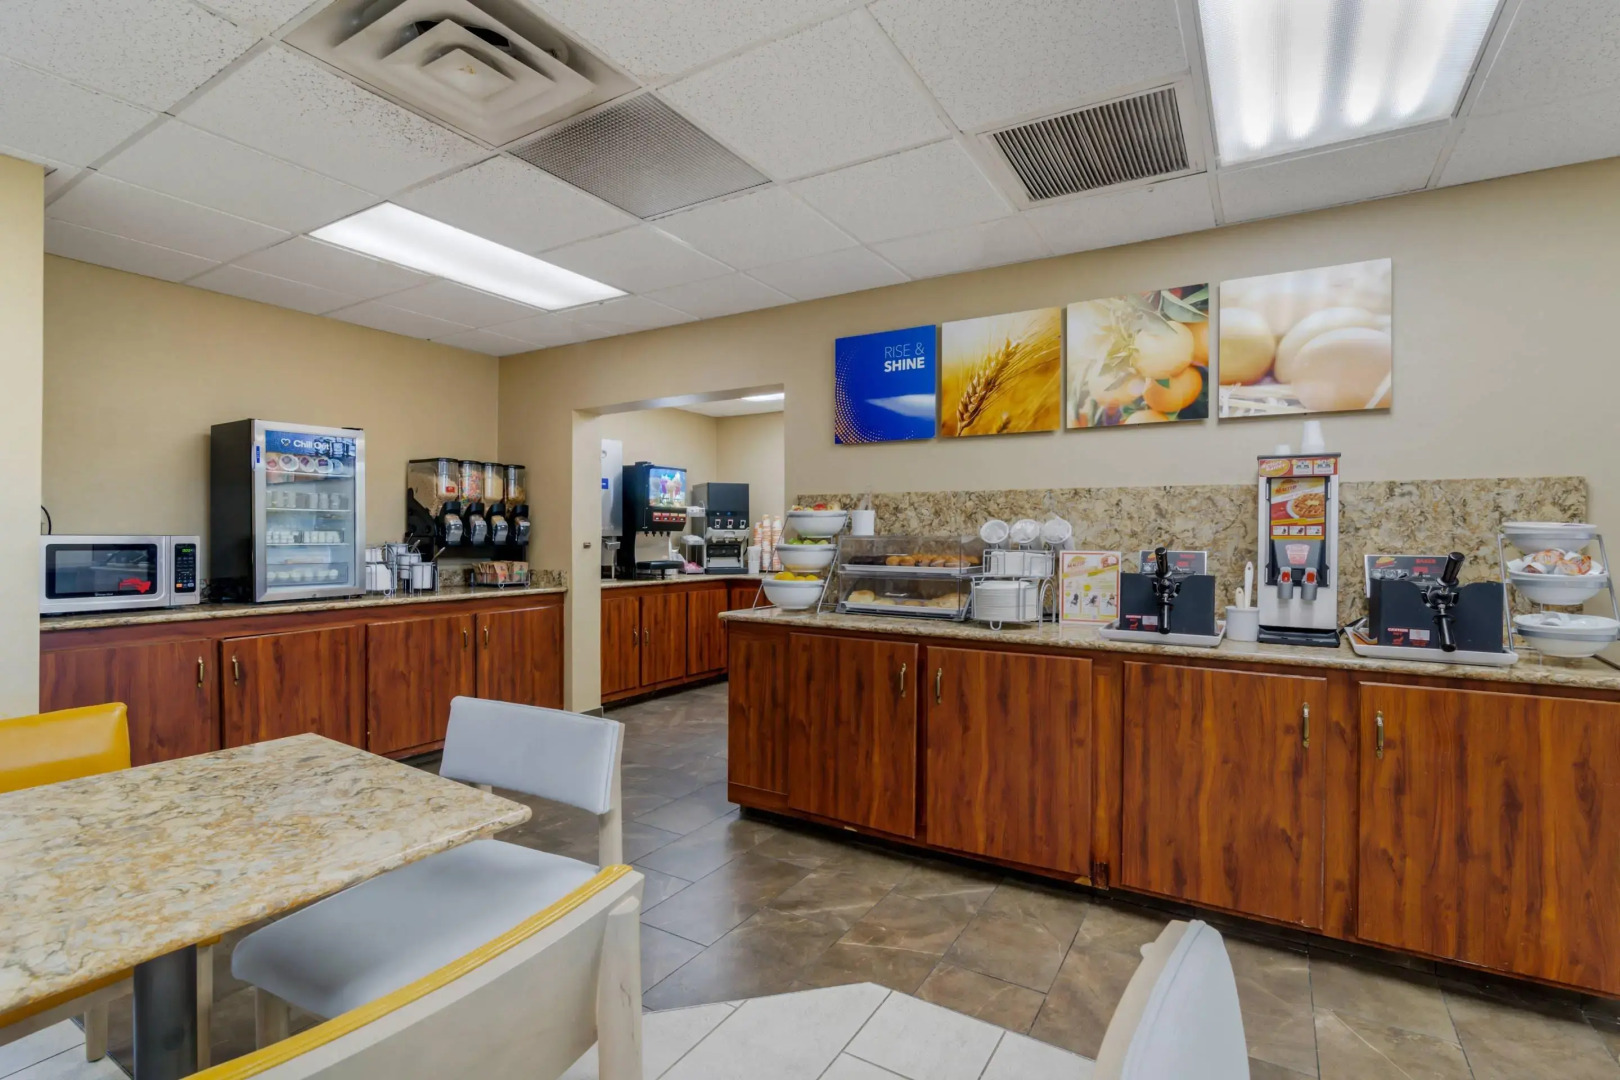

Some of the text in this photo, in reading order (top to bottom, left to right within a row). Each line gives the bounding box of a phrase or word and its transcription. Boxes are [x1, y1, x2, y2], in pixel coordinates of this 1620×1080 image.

[885, 342, 924, 358] RISE &
[884, 357, 925, 373] SHINE
[293, 439, 330, 450] Chill Out
